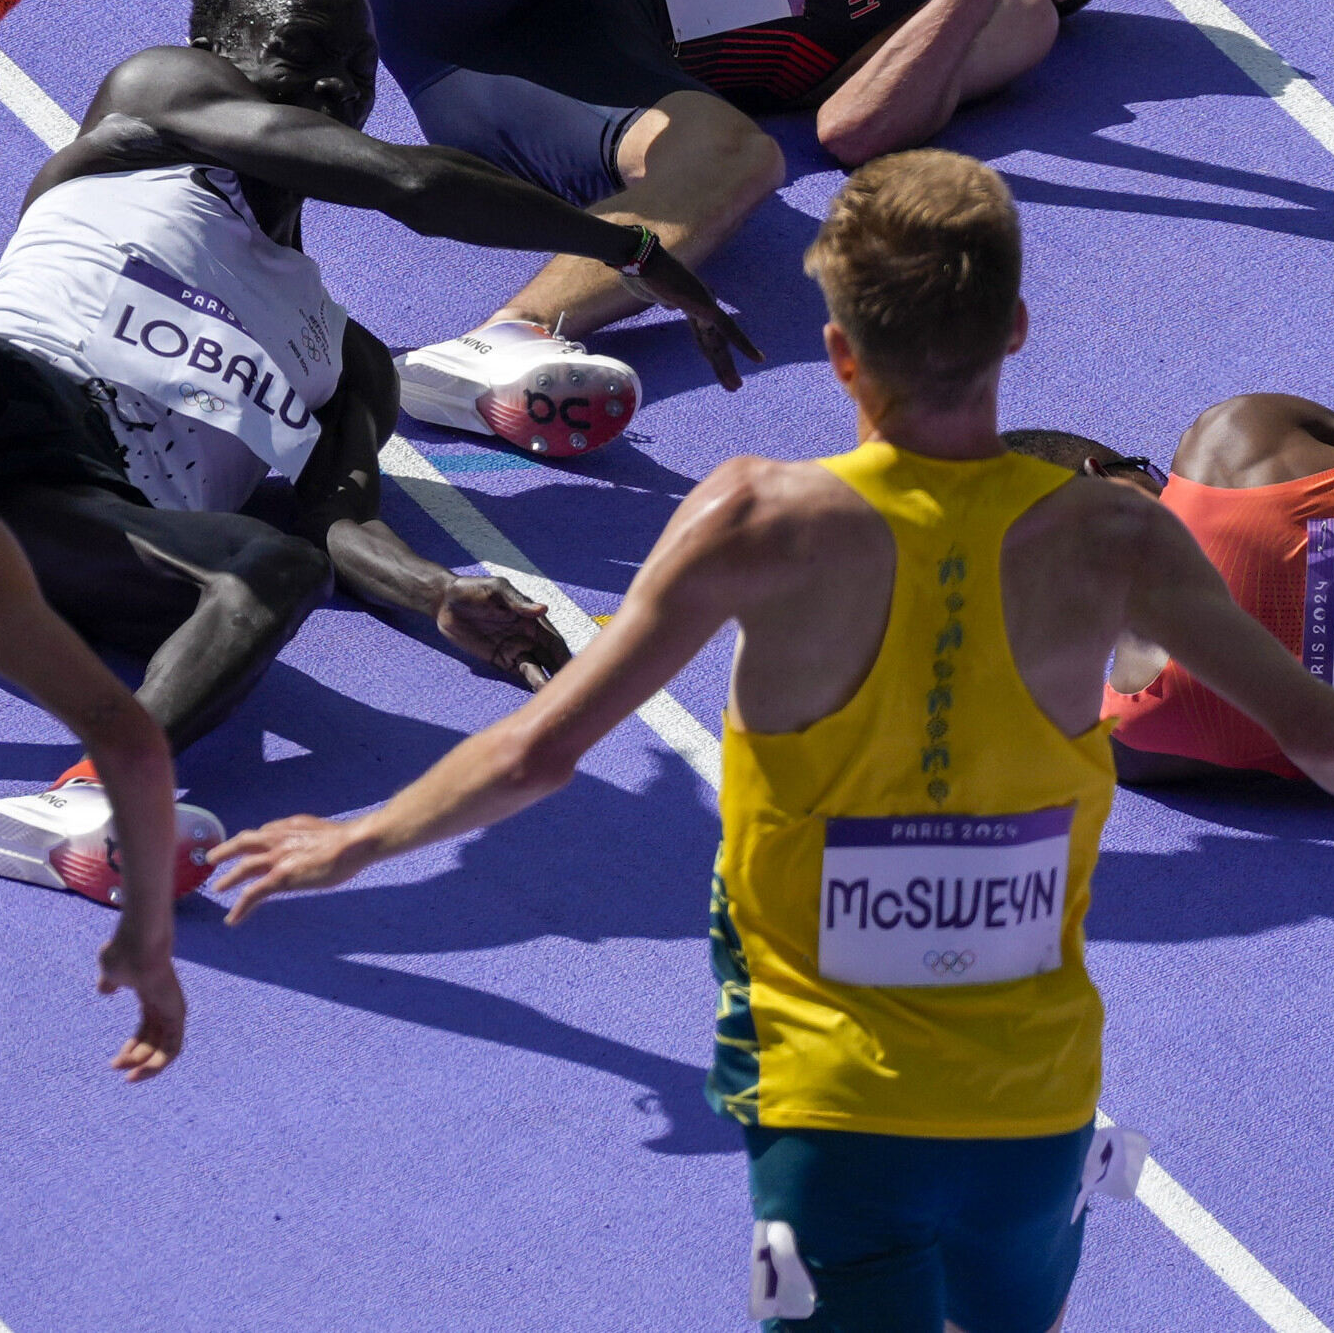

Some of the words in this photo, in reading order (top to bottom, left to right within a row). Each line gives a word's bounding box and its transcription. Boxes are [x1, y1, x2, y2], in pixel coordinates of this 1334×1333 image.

[113, 304, 310, 430] LOBALU
[456, 336, 493, 356] NING
[1312, 580, 1328, 634] 2024
[1310, 642, 1325, 675] RIS
[891, 822, 955, 840] PARIS
[961, 821, 1020, 841] 2024
[826, 866, 1058, 931] McSWEYN
[757, 1242, 779, 1300] 1
